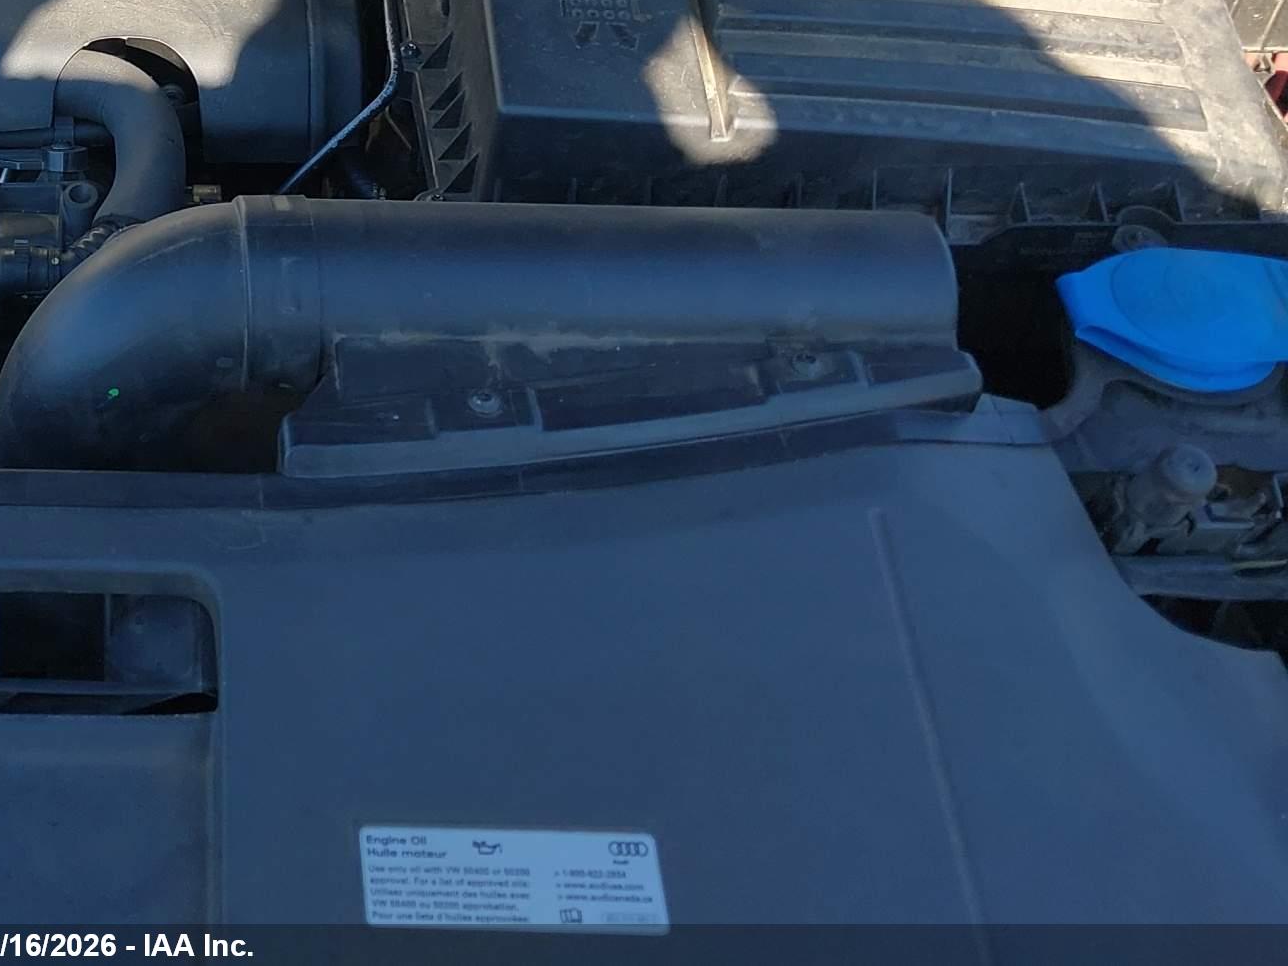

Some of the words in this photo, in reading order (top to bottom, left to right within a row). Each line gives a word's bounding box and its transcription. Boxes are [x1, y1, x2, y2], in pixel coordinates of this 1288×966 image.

[366, 835, 407, 846] Engine
[411, 835, 427, 846] Oil
[367, 848, 398, 858] Huile
[401, 849, 448, 859] moteur
[368, 866, 385, 874] Use
[388, 866, 407, 874] only
[424, 866, 442, 874] with
[447, 866, 460, 874] VW
[414, 877, 428, 885] For
[372, 899, 387, 908] VW
[372, 911, 393, 919] Pour
